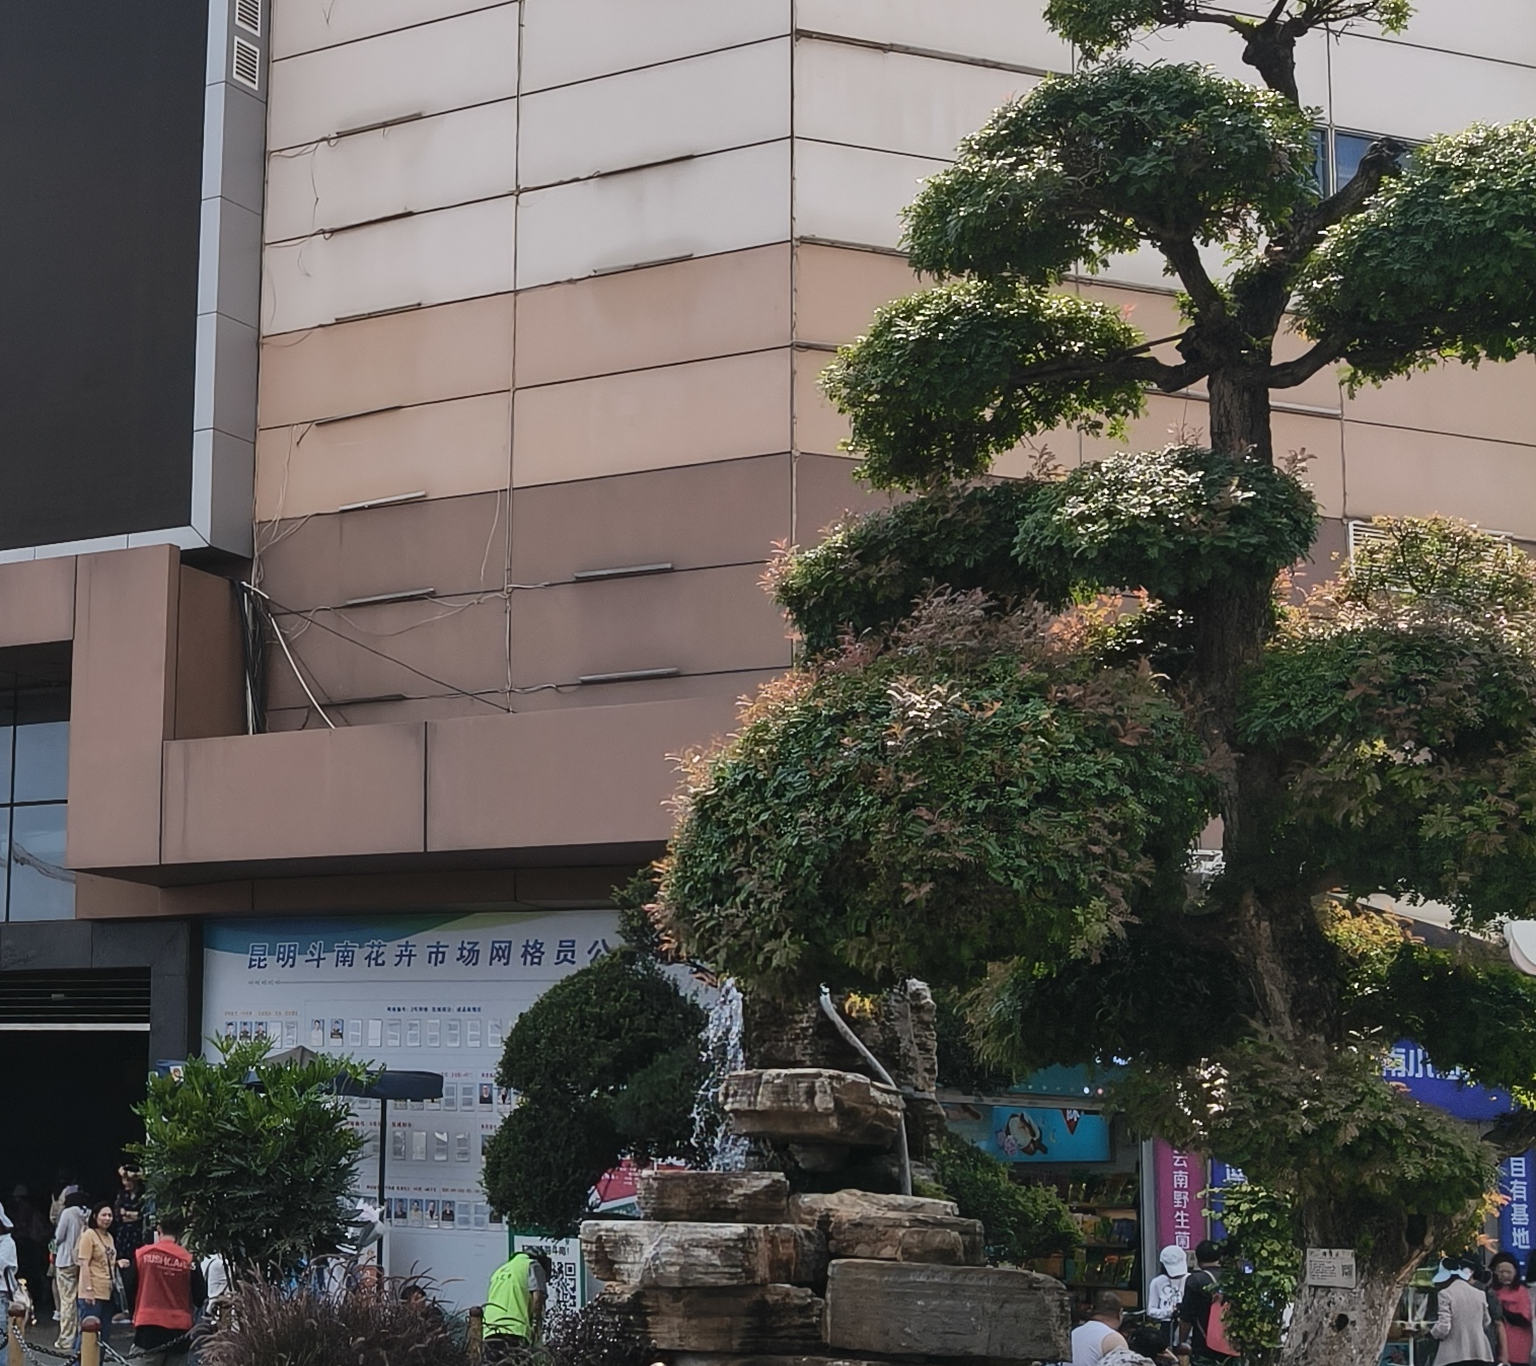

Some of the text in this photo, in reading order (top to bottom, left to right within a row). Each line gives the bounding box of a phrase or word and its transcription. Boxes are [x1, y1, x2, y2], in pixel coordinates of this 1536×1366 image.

[1172, 1149, 1191, 1250] 云南野生菌
